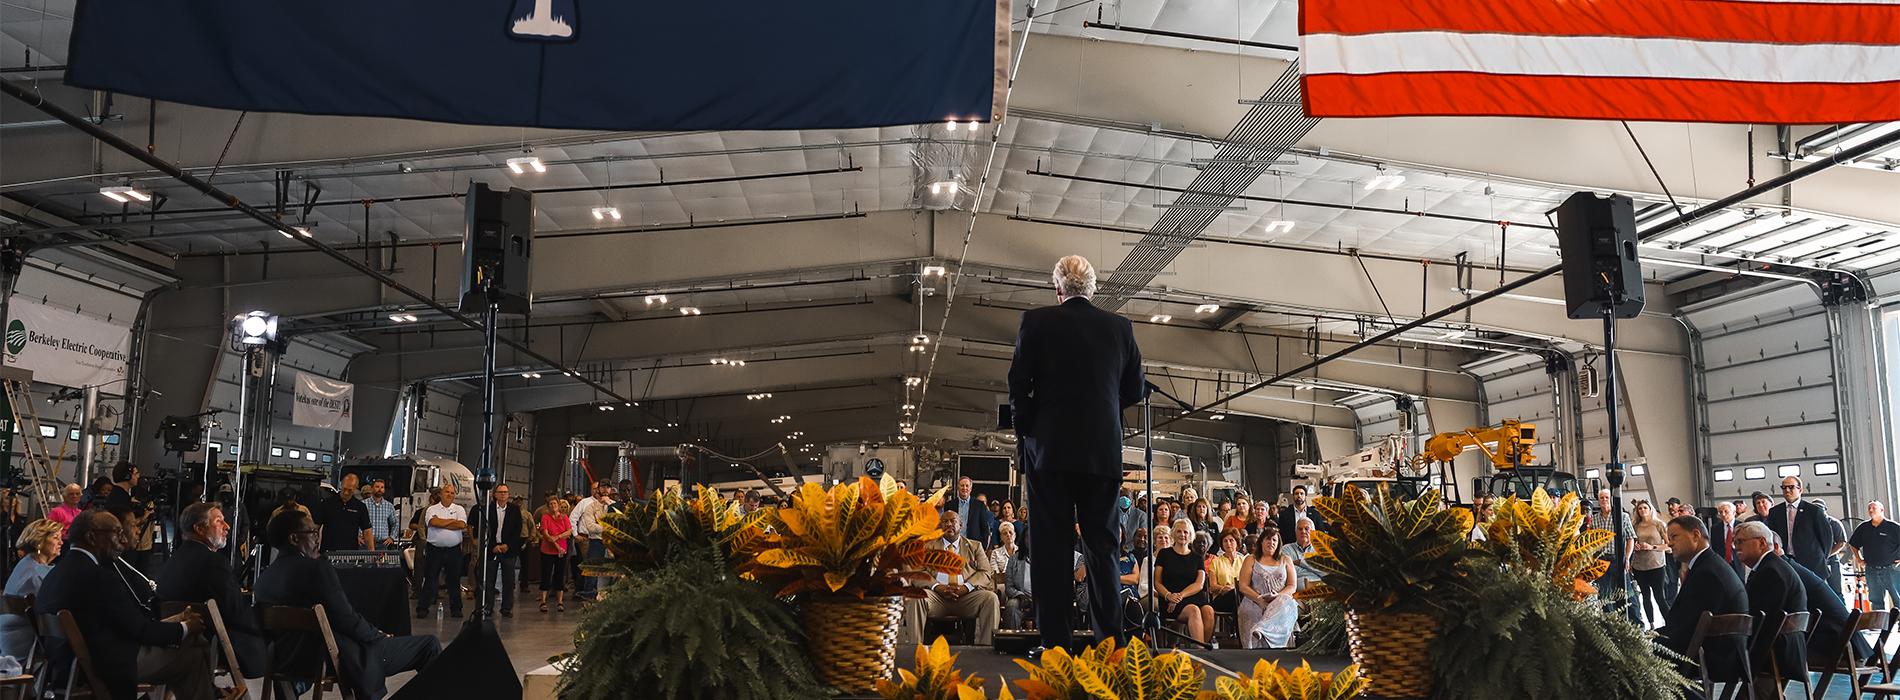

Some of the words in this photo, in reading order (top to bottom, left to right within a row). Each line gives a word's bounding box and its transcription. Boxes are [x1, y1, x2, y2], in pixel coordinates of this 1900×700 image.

[29, 330, 60, 350] Berkeley
[61, 338, 88, 354] Electric
[88, 344, 126, 362] Cooperative
